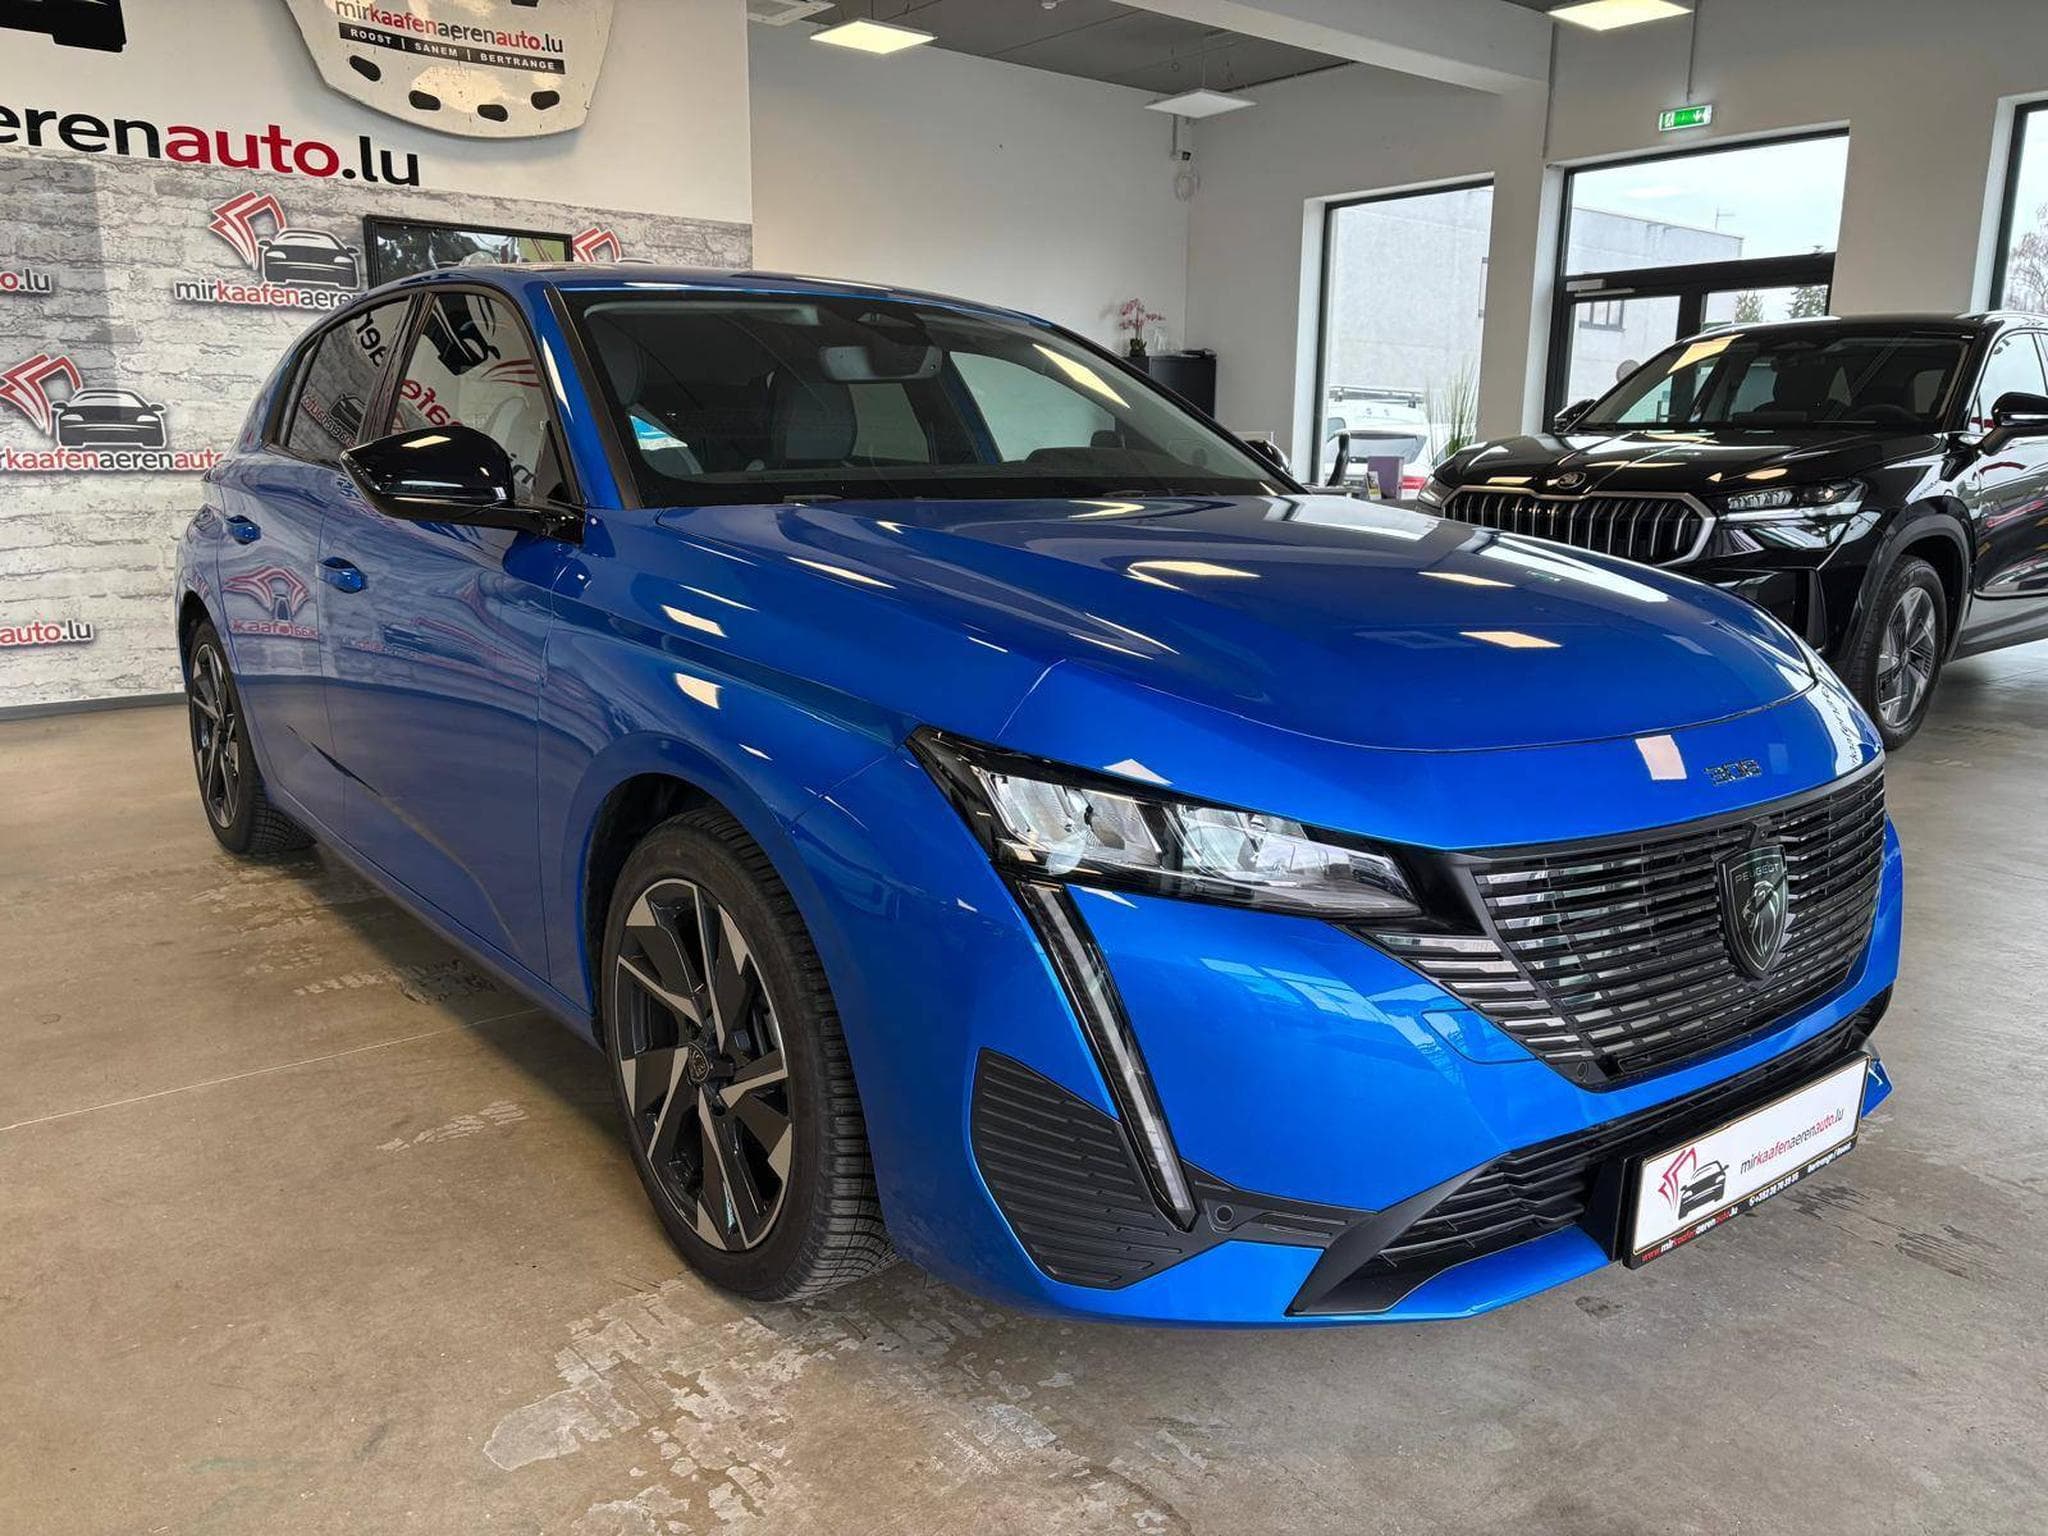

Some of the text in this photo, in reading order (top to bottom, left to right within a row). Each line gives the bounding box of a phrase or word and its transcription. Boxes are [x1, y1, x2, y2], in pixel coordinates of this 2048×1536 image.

[335, 0, 564, 53] mirkaafenaerenauto.lu
[350, 28, 556, 70] ROOST SANEM BERTRANGE
[175, 279, 357, 310] mirkaafenaere
[0, 448, 224, 470] kaafenaerenaut
[0, 619, 92, 644] auto.lu
[1703, 759, 1762, 787] 308
[1735, 862, 1780, 884] PEUGEOT
[1740, 1107, 1845, 1176] mirkaafenaerenauto.lu
